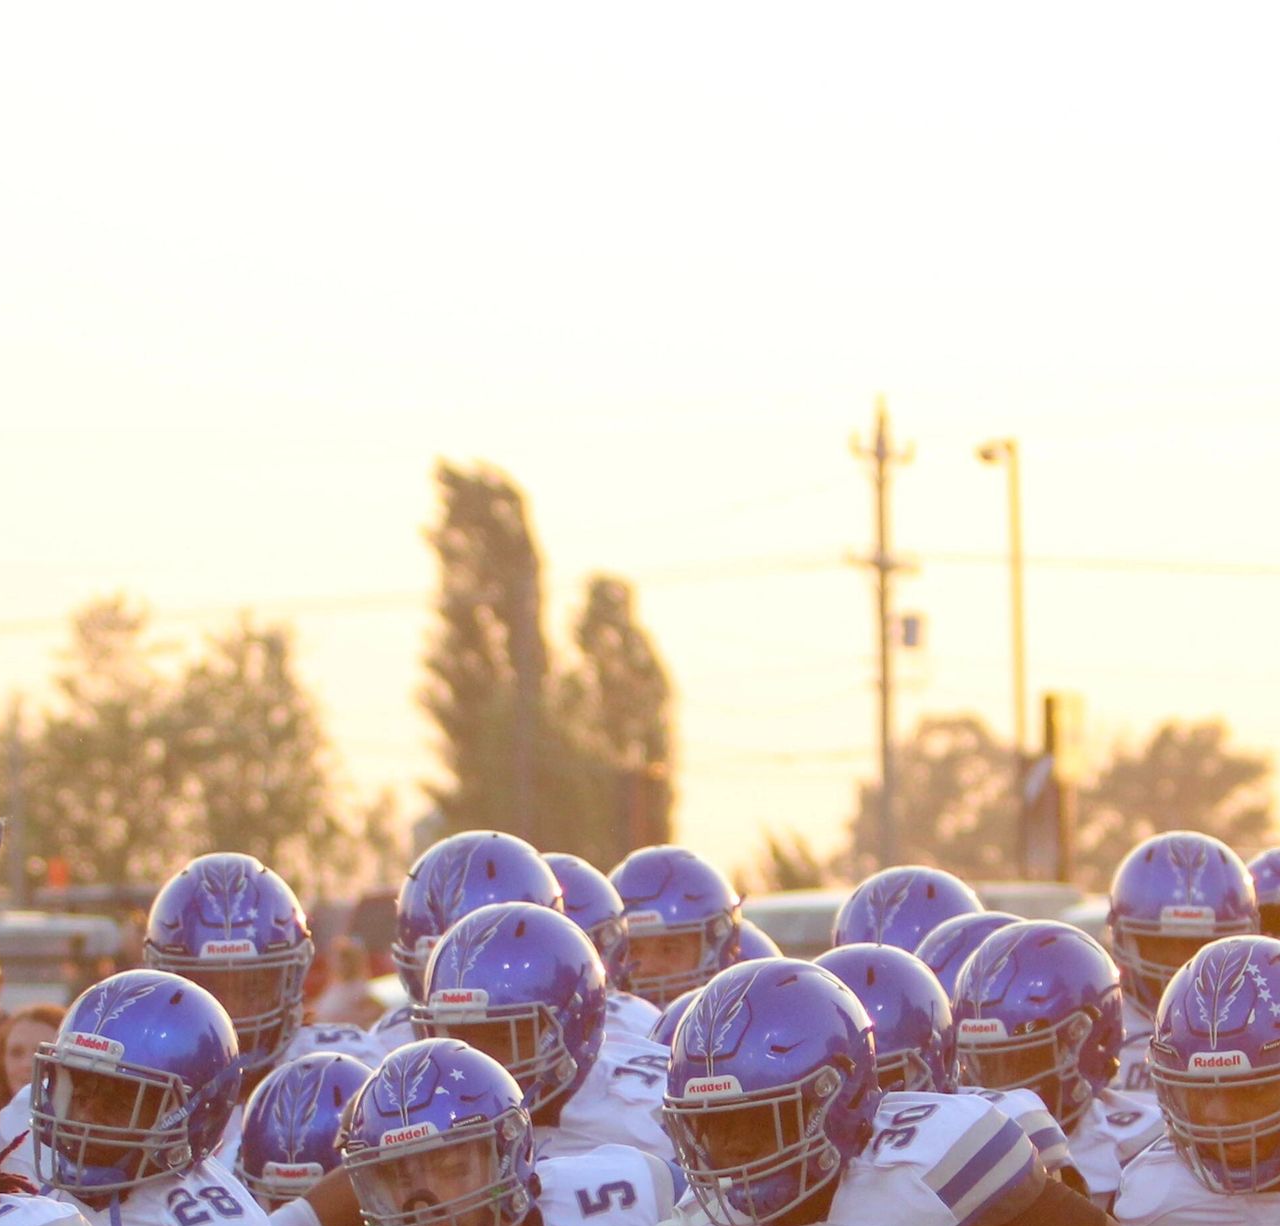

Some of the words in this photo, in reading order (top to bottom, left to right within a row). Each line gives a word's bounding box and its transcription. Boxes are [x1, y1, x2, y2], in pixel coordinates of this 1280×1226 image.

[207, 943, 251, 955] Riddell
[962, 1024, 998, 1034] Riddell
[75, 1034, 110, 1051] Riddell
[1194, 1055, 1241, 1068] Riddell
[689, 1081, 732, 1094] Riddell
[384, 1126, 429, 1145] Riddell
[873, 1103, 942, 1157] 30
[576, 1180, 637, 1218] 5
